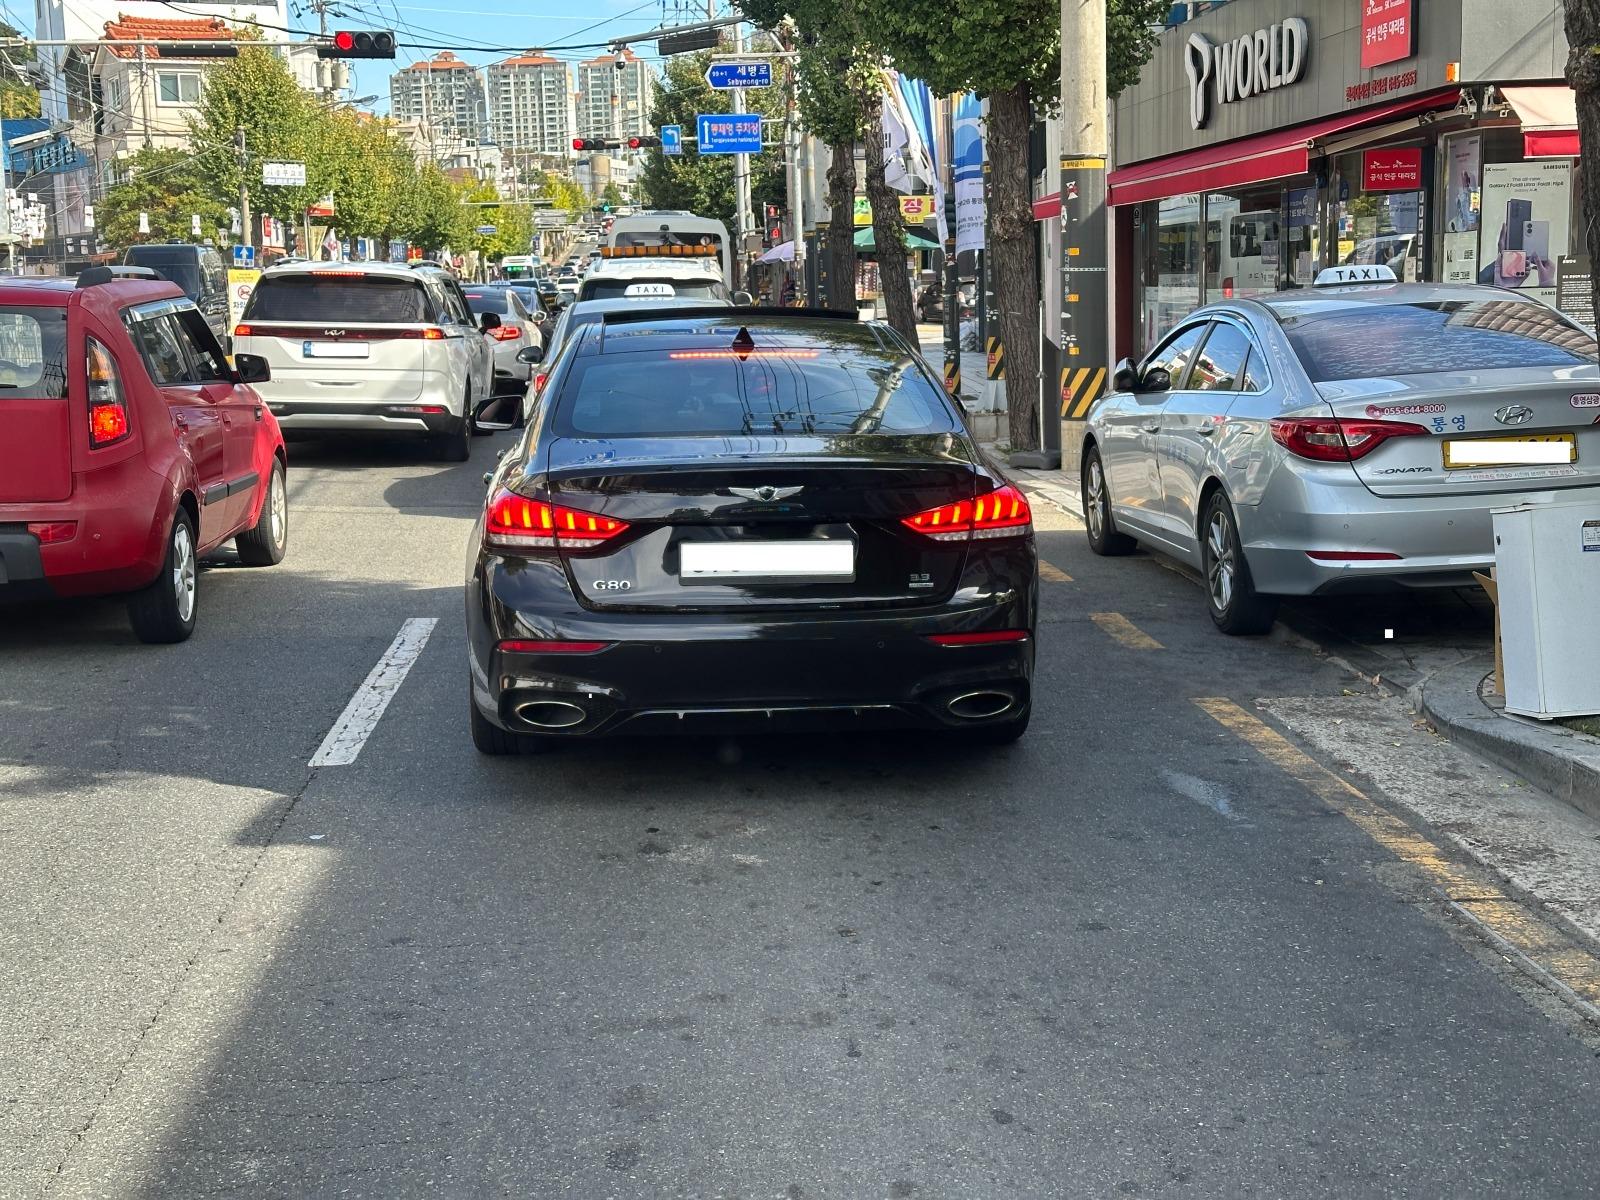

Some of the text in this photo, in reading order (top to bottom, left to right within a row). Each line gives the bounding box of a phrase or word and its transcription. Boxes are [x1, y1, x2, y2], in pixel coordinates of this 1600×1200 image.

[1366, 17, 1405, 45] 공식 인증 대리점
[1215, 17, 1308, 104] WORLD
[737, 65, 768, 77] 세병로
[1370, 172, 1416, 181] 공식 인증 대리점
[903, 198, 923, 214] 장
[1336, 268, 1380, 281] TAXI
[1384, 404, 1446, 416] 055-644-8000
[592, 580, 631, 590] G80
